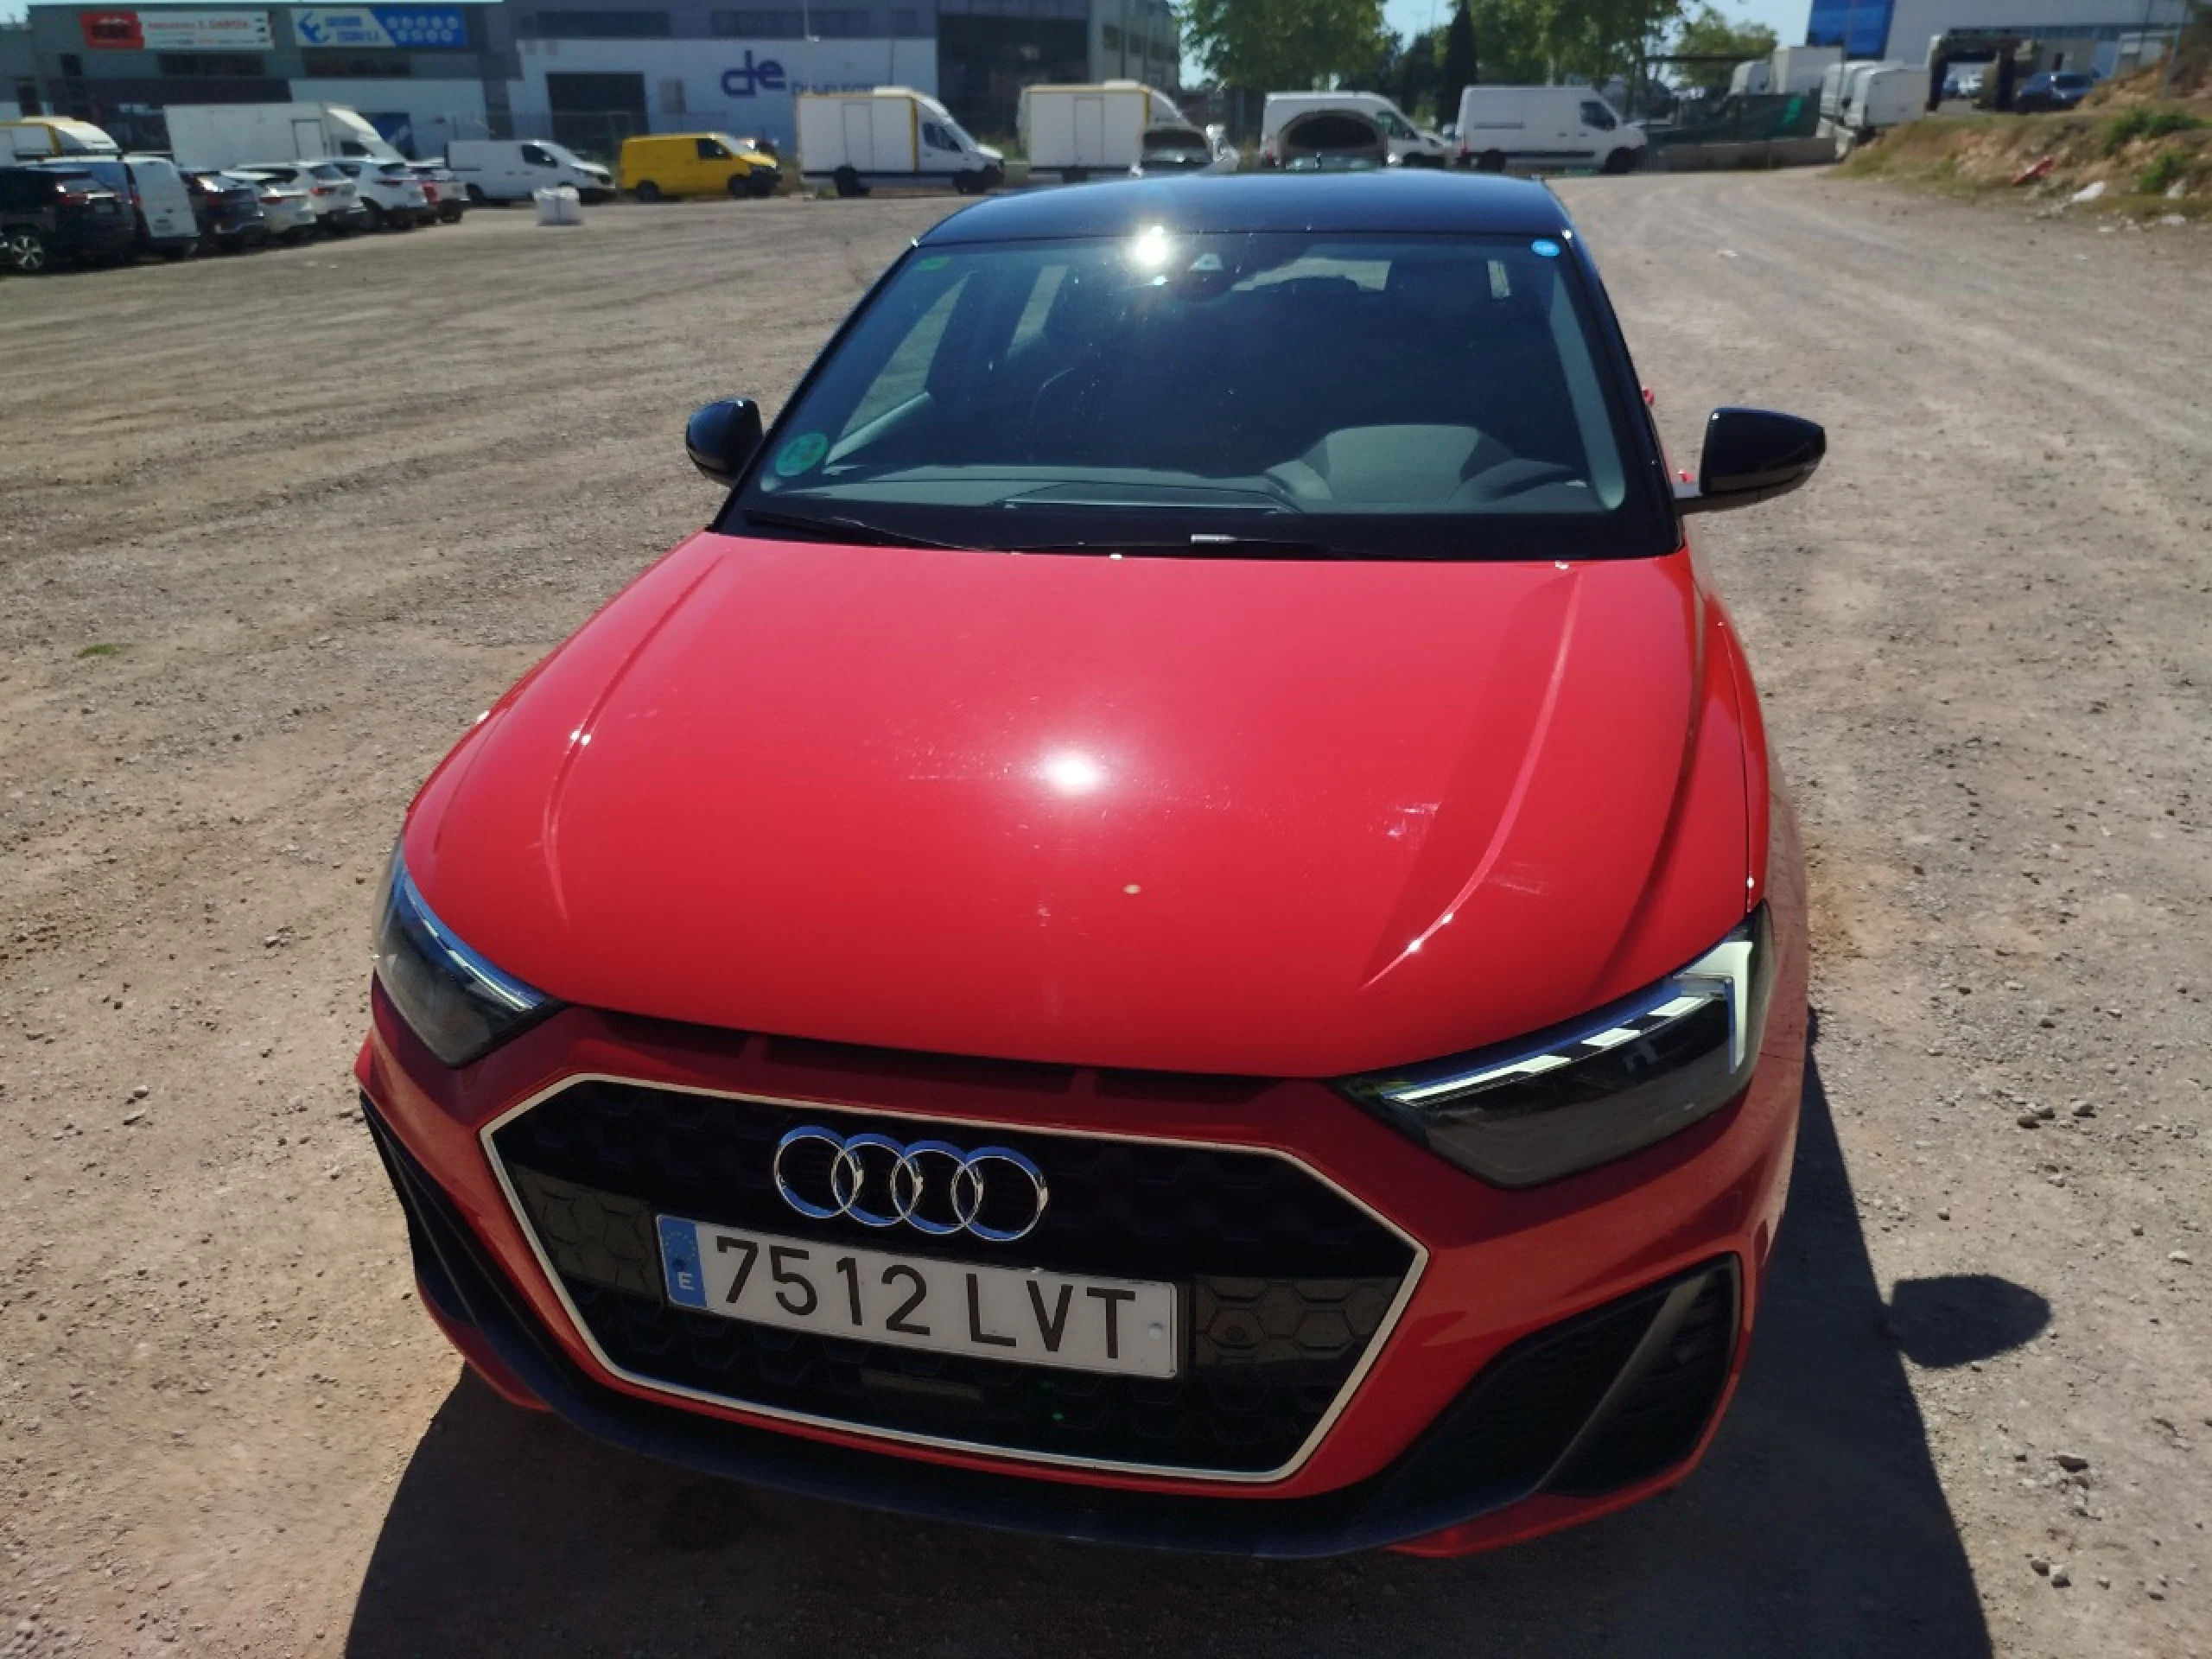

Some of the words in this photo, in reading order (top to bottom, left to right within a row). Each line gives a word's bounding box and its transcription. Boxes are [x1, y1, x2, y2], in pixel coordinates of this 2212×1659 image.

[677, 1271, 695, 1288] E
[715, 1235, 931, 1336] 7512
[965, 1273, 1136, 1359] LVT
